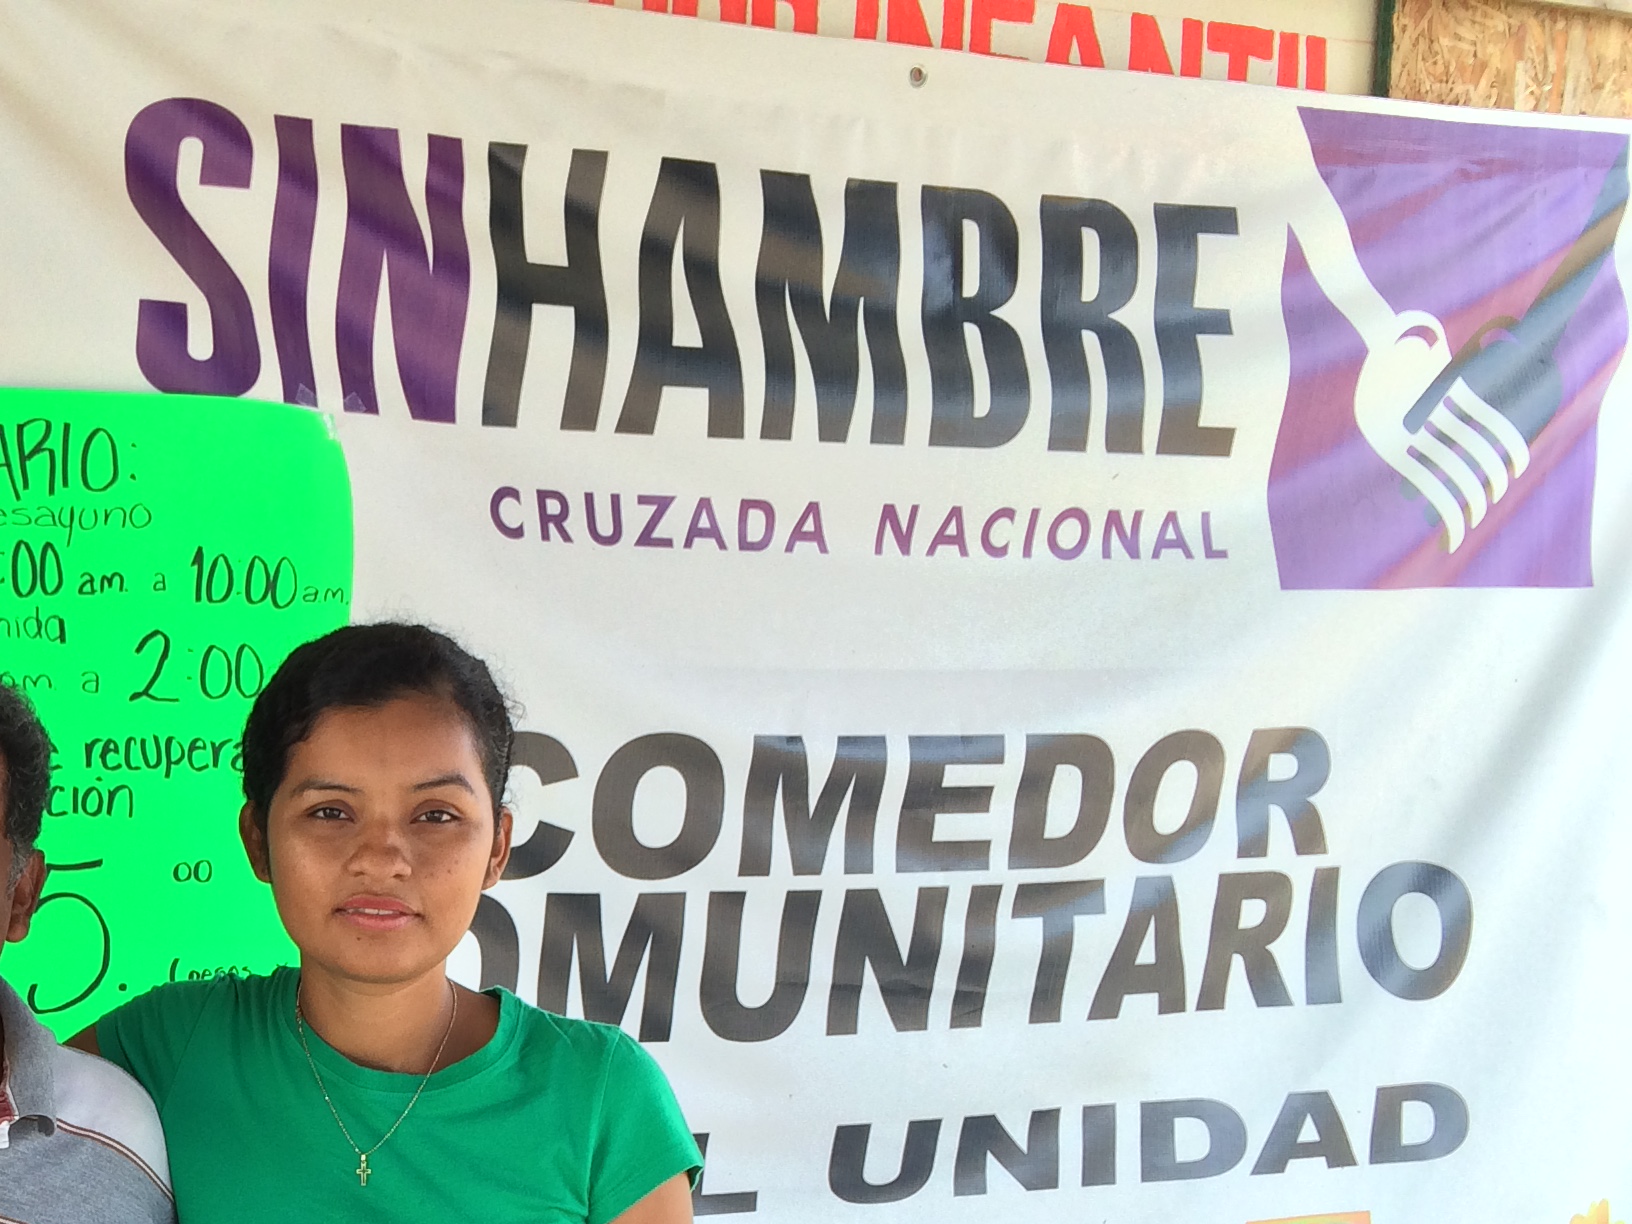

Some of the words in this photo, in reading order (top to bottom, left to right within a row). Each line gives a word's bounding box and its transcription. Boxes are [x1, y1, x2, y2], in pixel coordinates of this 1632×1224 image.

[489, 486, 830, 554] CRUZADA
[874, 501, 1229, 560] NACIONAL
[152, 573, 167, 592] a
[191, 546, 299, 609] 10:00
[81, 671, 100, 693] a
[129, 629, 265, 702] 2:00
[500, 724, 1331, 881] COMEDOR
[827, 1080, 1470, 1205] UNIDAD
